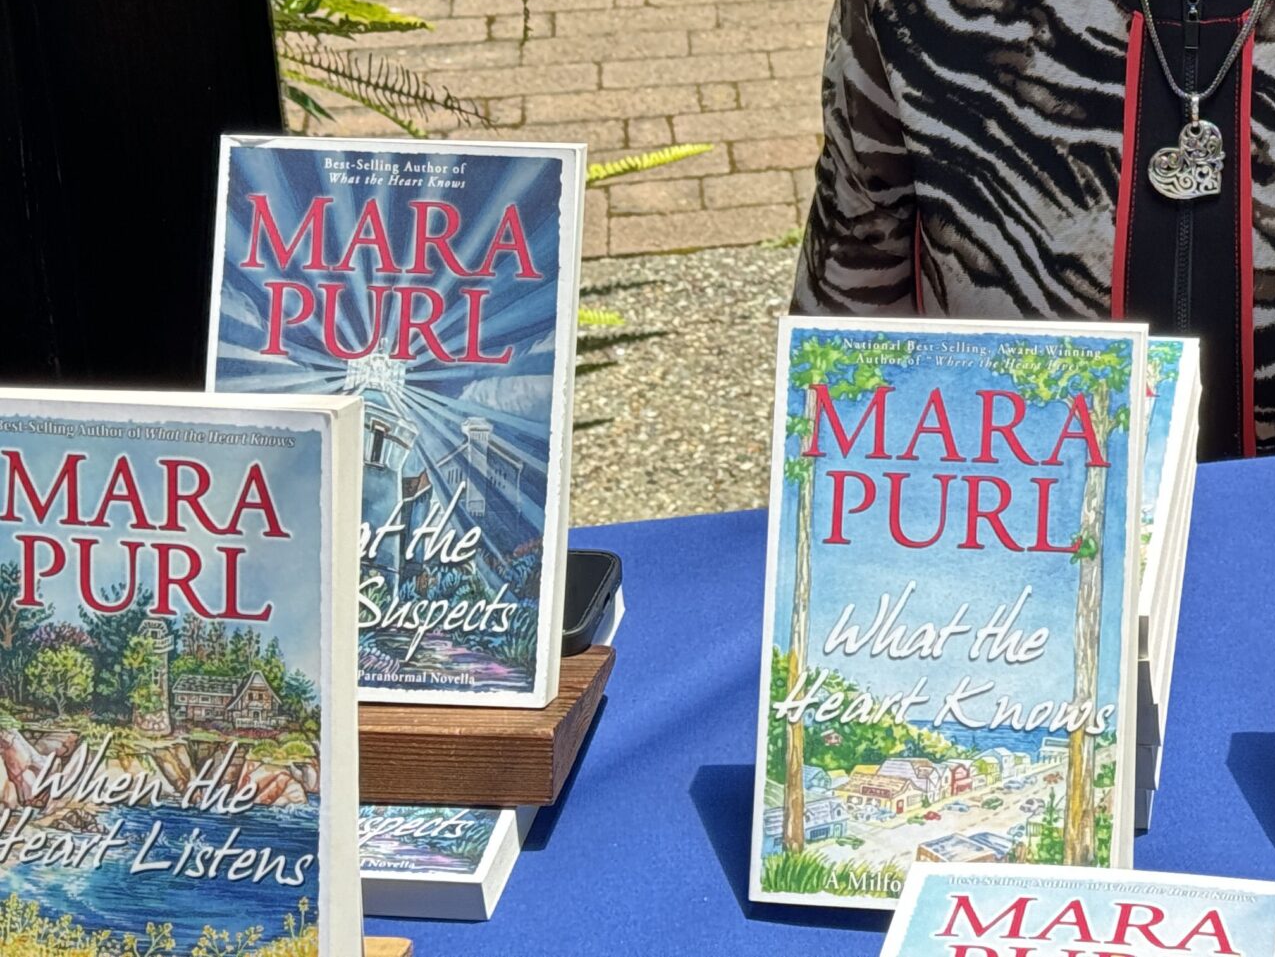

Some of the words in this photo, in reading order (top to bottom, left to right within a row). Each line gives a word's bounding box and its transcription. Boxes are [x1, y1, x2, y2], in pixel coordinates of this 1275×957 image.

[324, 157, 400, 174] Best-Selling
[404, 161, 448, 174] Author
[452, 162, 467, 174] of
[329, 172, 360, 185] What
[365, 173, 384, 186] the
[388, 175, 423, 187] Heart
[428, 176, 466, 189] Knows
[240, 194, 544, 279] MARA
[260, 281, 513, 365] PURL
[843, 337, 901, 351] National
[856, 352, 902, 365] Author
[907, 353, 922, 366] of
[79, 423, 123, 438] Author
[127, 425, 141, 439] of
[145, 427, 180, 442] What
[183, 430, 205, 443] the
[208, 430, 248, 445] Heart
[250, 433, 296, 448] Knows
[802, 383, 1111, 468] MARA
[0, 450, 291, 538] MARA
[404, 481, 481, 564] the
[822, 470, 1083, 554] PURL
[15, 534, 273, 621] PURL
[358, 576, 517, 663] Suspects
[822, 580, 971, 661] What
[968, 584, 1050, 665] the
[357, 670, 427, 684] Paranormal
[430, 672, 476, 685] Novella
[772, 668, 930, 726] Heart
[933, 675, 1115, 736] Knows
[31, 732, 163, 809] When
[181, 740, 259, 814] the
[0, 806, 128, 870] Heart
[130, 819, 313, 887] Listens
[358, 808, 475, 847] spects
[824, 871, 839, 890] A
[848, 870, 902, 892] Milfo
[935, 895, 1243, 956] MARA
